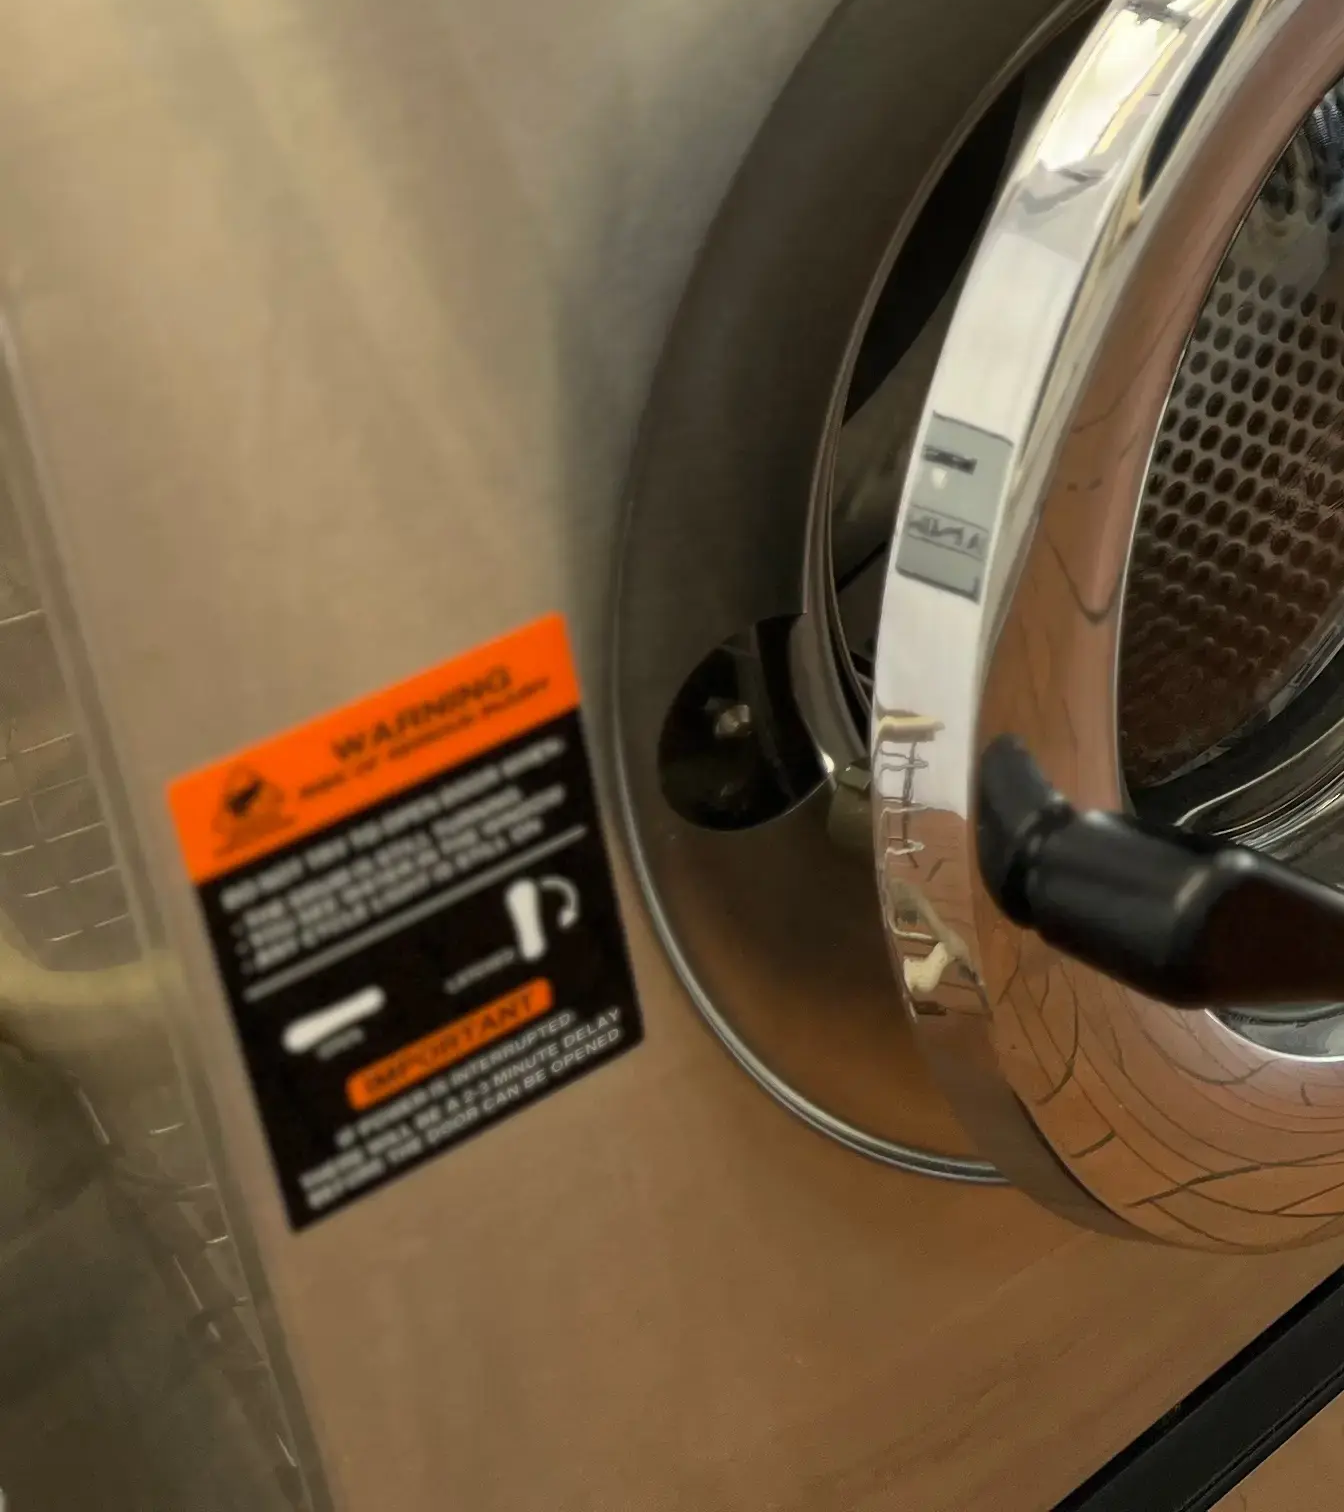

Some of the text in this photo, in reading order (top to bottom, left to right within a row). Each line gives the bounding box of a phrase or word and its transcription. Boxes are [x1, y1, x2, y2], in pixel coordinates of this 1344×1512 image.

[450, 1009, 573, 1089] INTERRUPTED
[481, 1084, 521, 1116] CAN
[523, 1067, 549, 1092] BE
[549, 1026, 621, 1075] OPENED
[492, 1041, 561, 1088] MINUTE
[562, 1005, 621, 1051] DELAY
